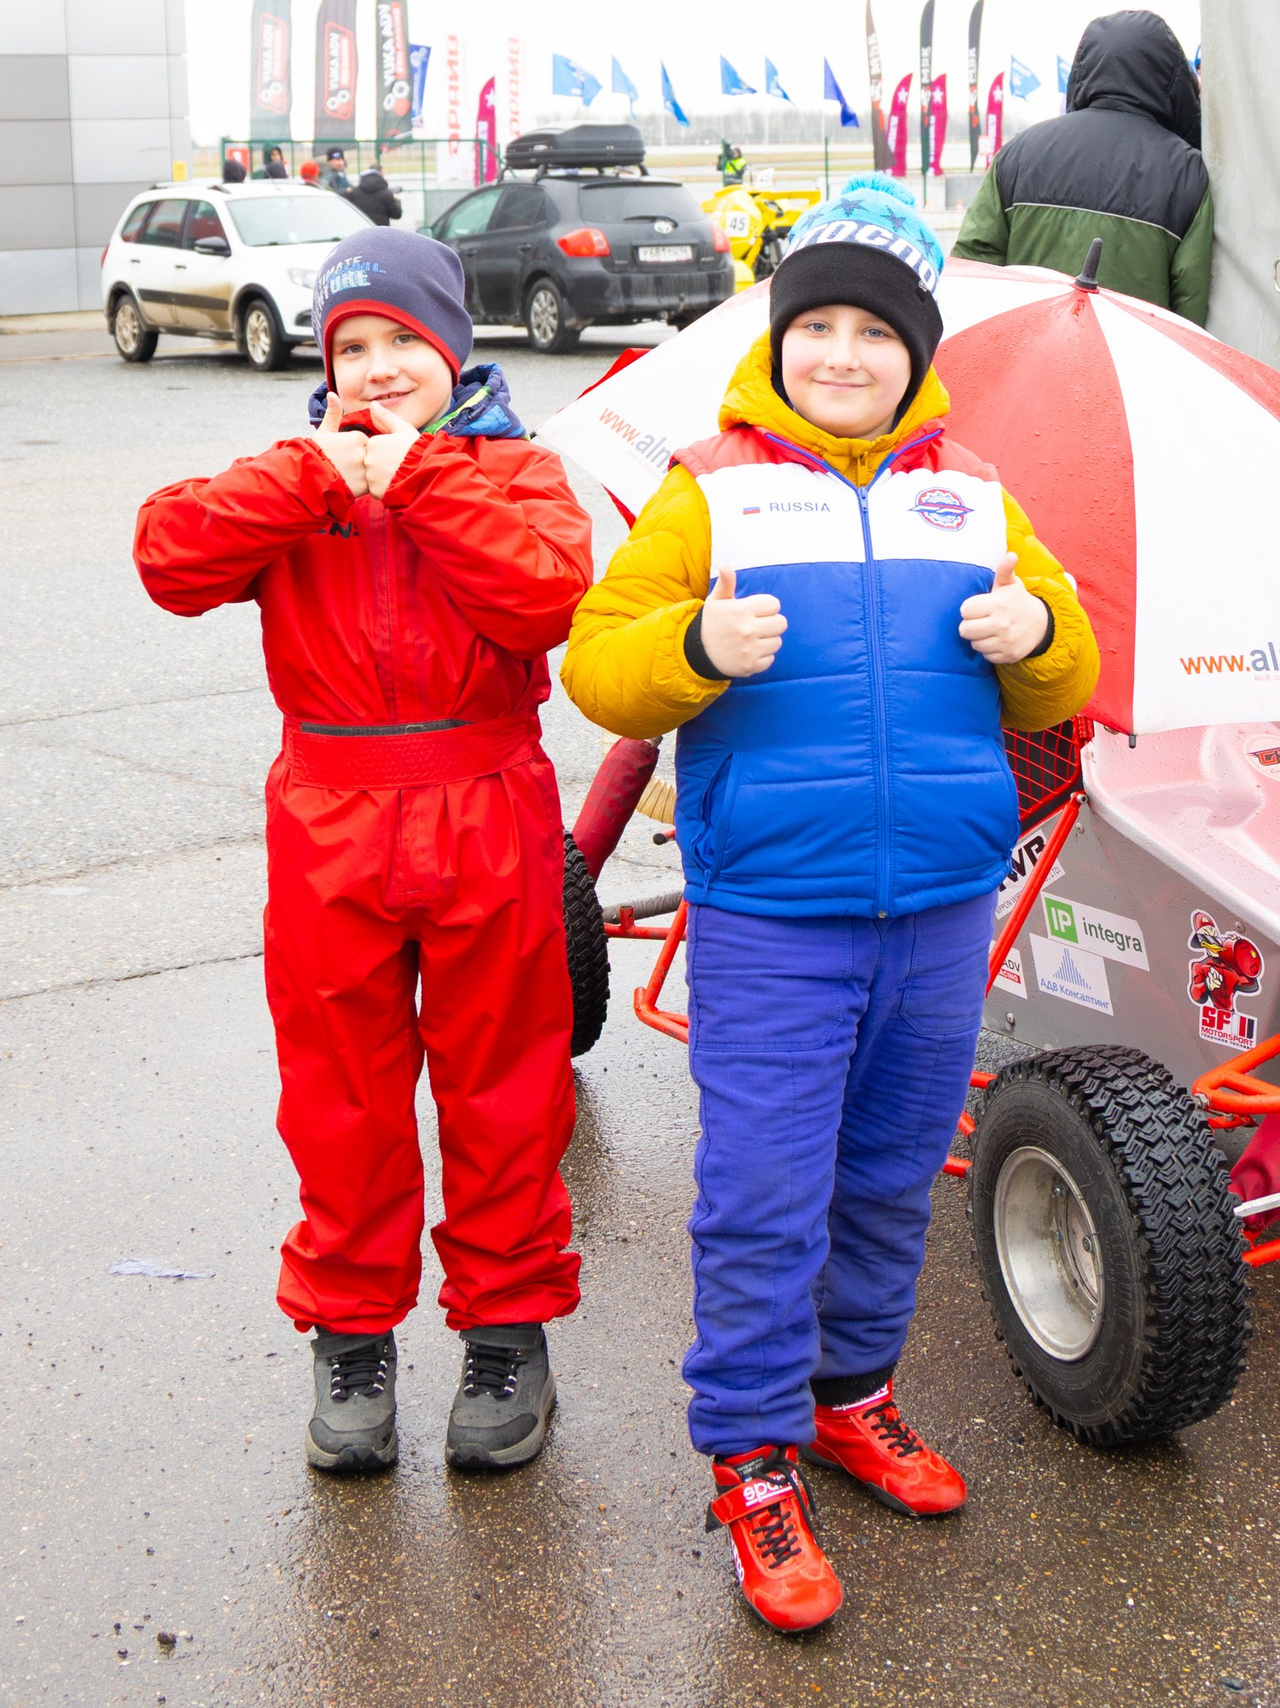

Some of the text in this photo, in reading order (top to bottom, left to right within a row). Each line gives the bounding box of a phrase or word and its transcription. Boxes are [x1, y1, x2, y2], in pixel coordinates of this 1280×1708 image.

[729, 216, 746, 231] 45
[769, 502, 831, 512] RUSSIA
[1082, 916, 1143, 952] integra
[1040, 978, 1109, 1009] АДВ Консалтинг
[1200, 1026, 1254, 1047] MOTORSPORT
